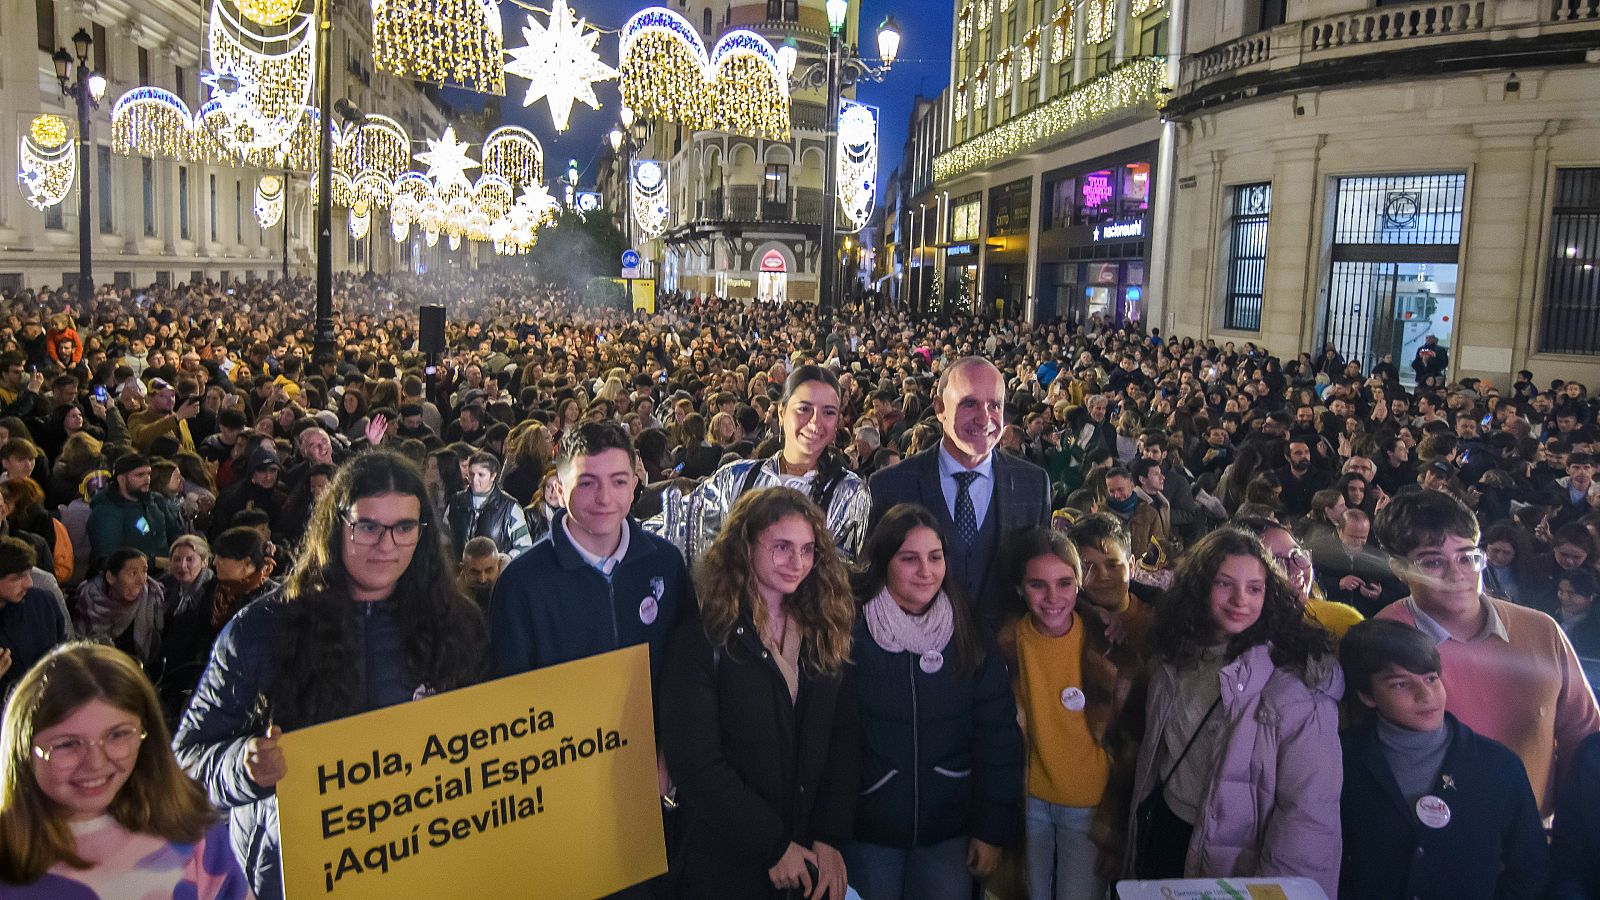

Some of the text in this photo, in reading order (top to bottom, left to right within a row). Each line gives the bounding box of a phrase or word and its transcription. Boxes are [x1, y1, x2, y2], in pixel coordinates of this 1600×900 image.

[316, 706, 556, 797] Hola, Agencia
[320, 727, 629, 841] Espacial Española.
[323, 785, 546, 895] ¡Aquí Sevilla!
